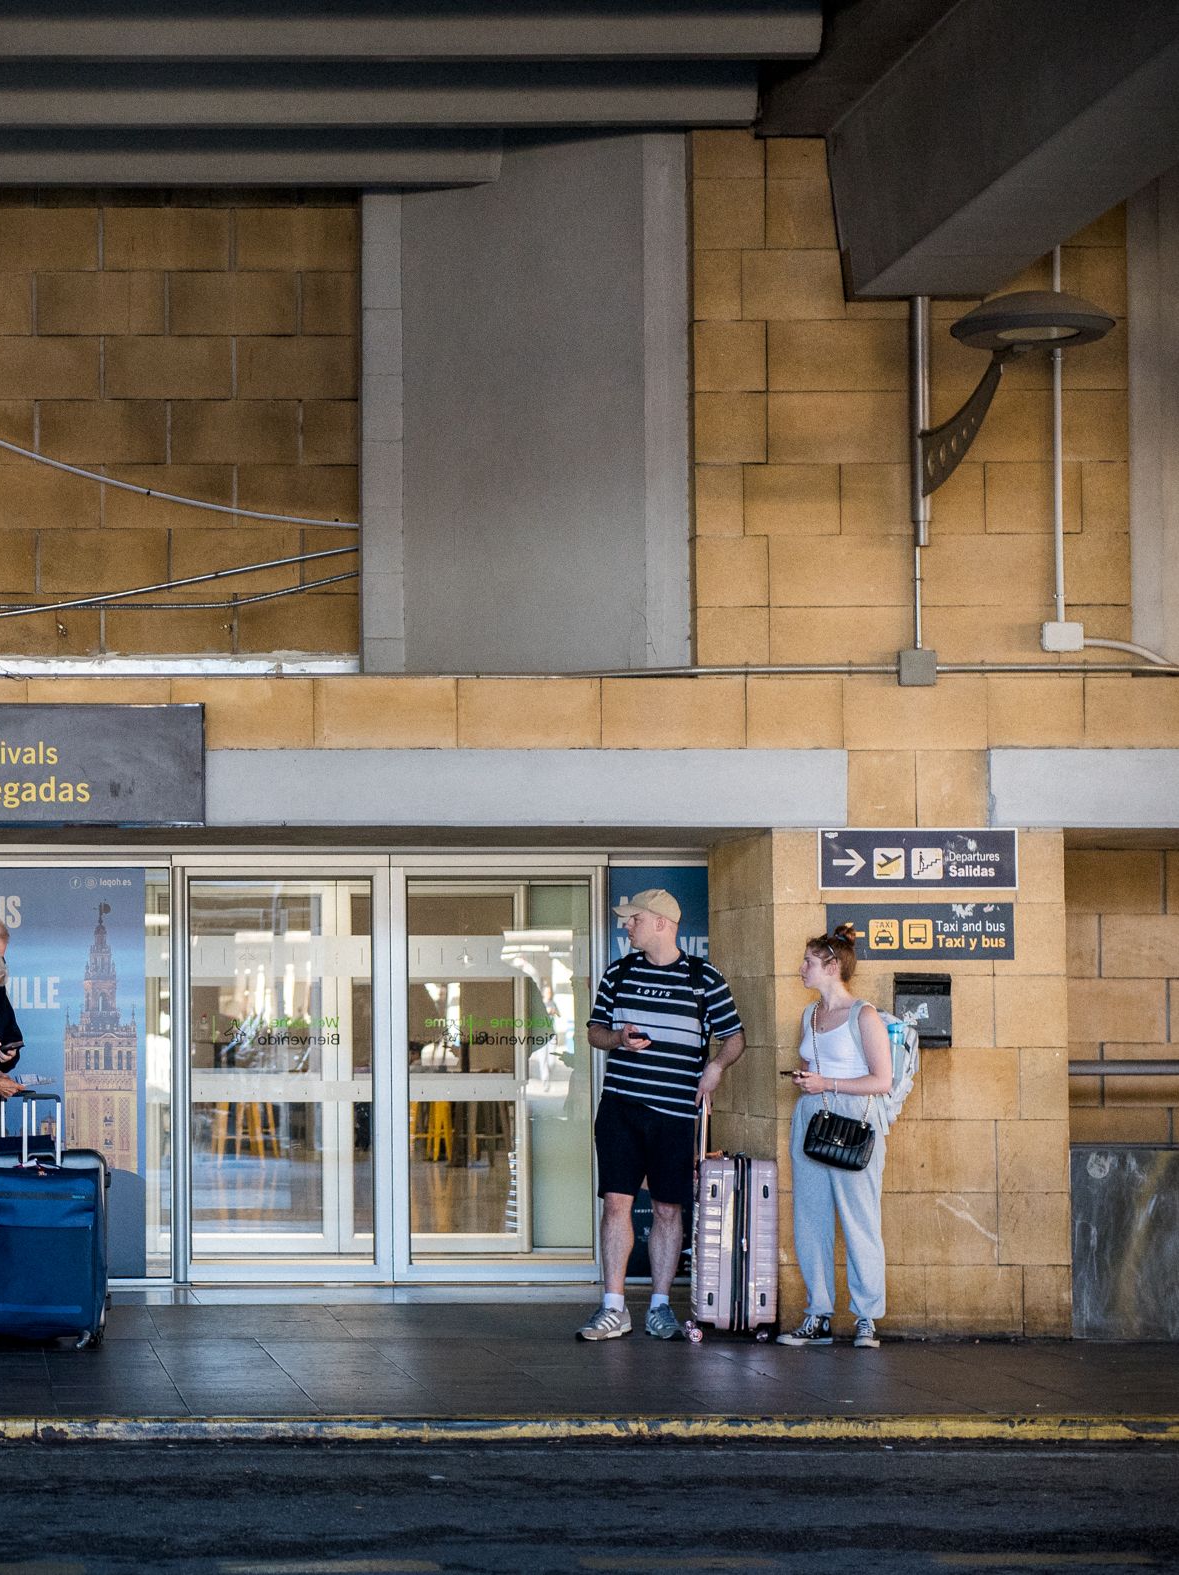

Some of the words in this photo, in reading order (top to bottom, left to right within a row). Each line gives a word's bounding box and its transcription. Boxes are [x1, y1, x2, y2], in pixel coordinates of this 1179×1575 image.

[949, 851, 1000, 863] Departures
[949, 865, 996, 878] Salidas
[874, 921, 894, 929] TAXI
[936, 920, 958, 932] Taxi
[962, 920, 982, 932] and
[985, 920, 1006, 932] bus
[936, 935, 965, 948] Taxi
[969, 938, 978, 950] y
[981, 935, 1006, 948] bus
